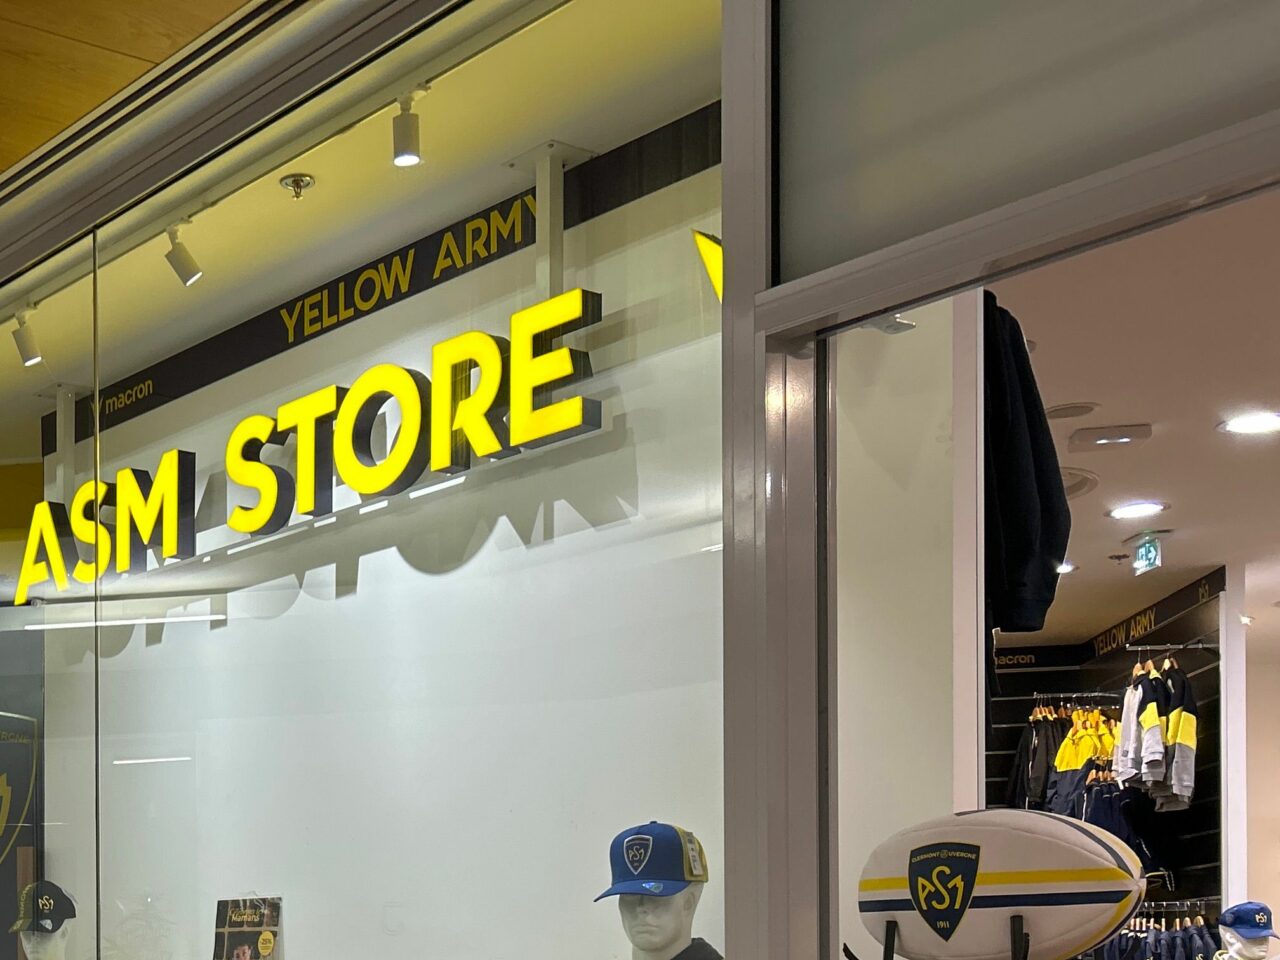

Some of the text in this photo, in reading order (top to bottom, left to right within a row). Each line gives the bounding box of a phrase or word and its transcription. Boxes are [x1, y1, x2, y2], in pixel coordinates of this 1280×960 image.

[280, 249, 415, 343] YELLOW
[105, 378, 153, 414] macron
[14, 288, 584, 606] ASM STORE
[1093, 608, 1157, 657] YELLOW ARMY
[912, 852, 940, 862] CLERMONT
[917, 865, 964, 911] ASM
[937, 921, 950, 929] 1911
